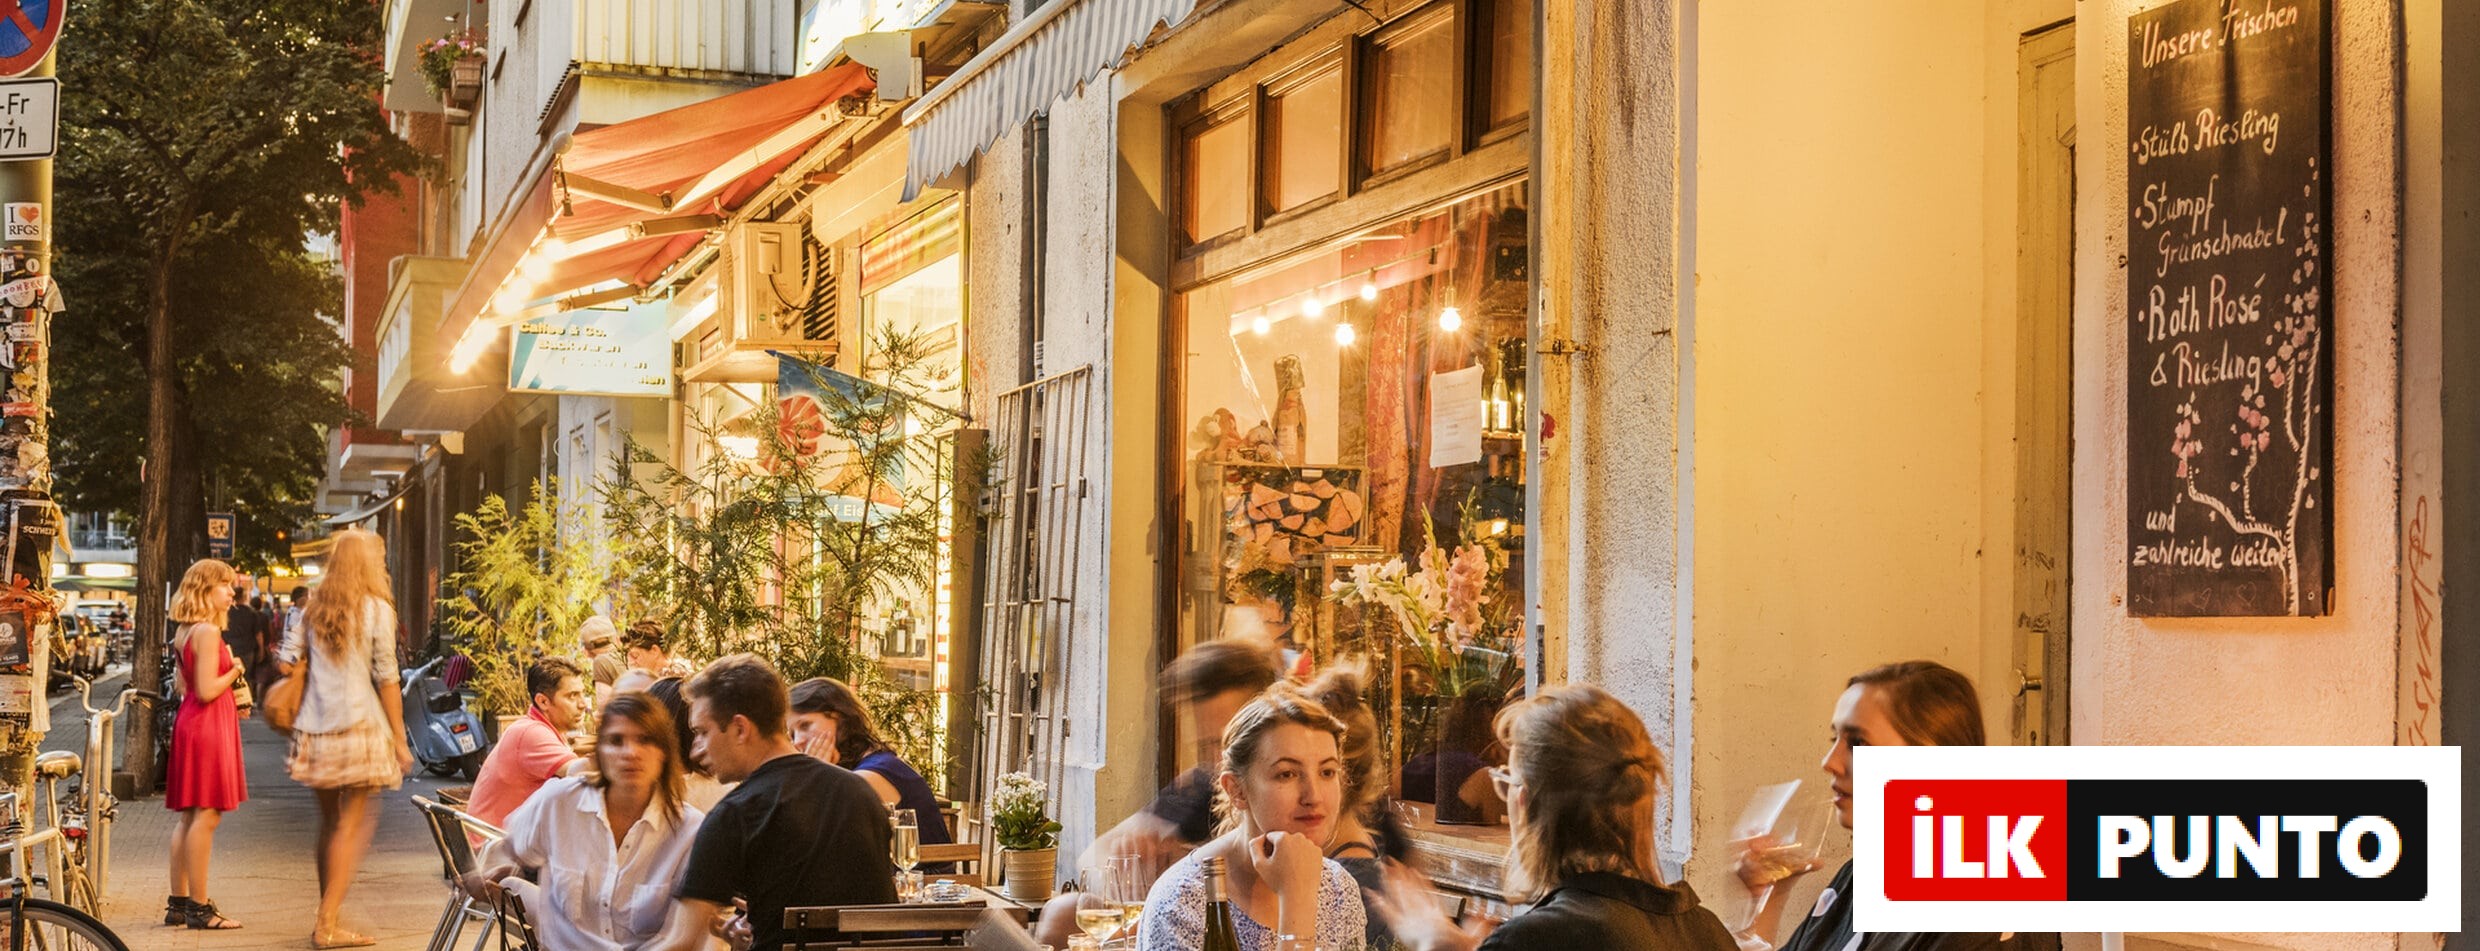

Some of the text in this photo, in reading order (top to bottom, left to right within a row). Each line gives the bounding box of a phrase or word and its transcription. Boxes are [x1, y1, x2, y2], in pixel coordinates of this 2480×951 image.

[2142, 21, 2213, 68] Unsere
[2194, 107, 2280, 156] Riesling
[2141, 174, 2219, 235] Stumpf
[9, 225, 39, 235] RFGS
[2157, 207, 2287, 278] Grünschnabel
[2147, 273, 2266, 344] Roth Rosé
[2151, 339, 2261, 394] & Riesling
[2146, 503, 2176, 533] und
[2133, 535, 2223, 569] zahlreiche
